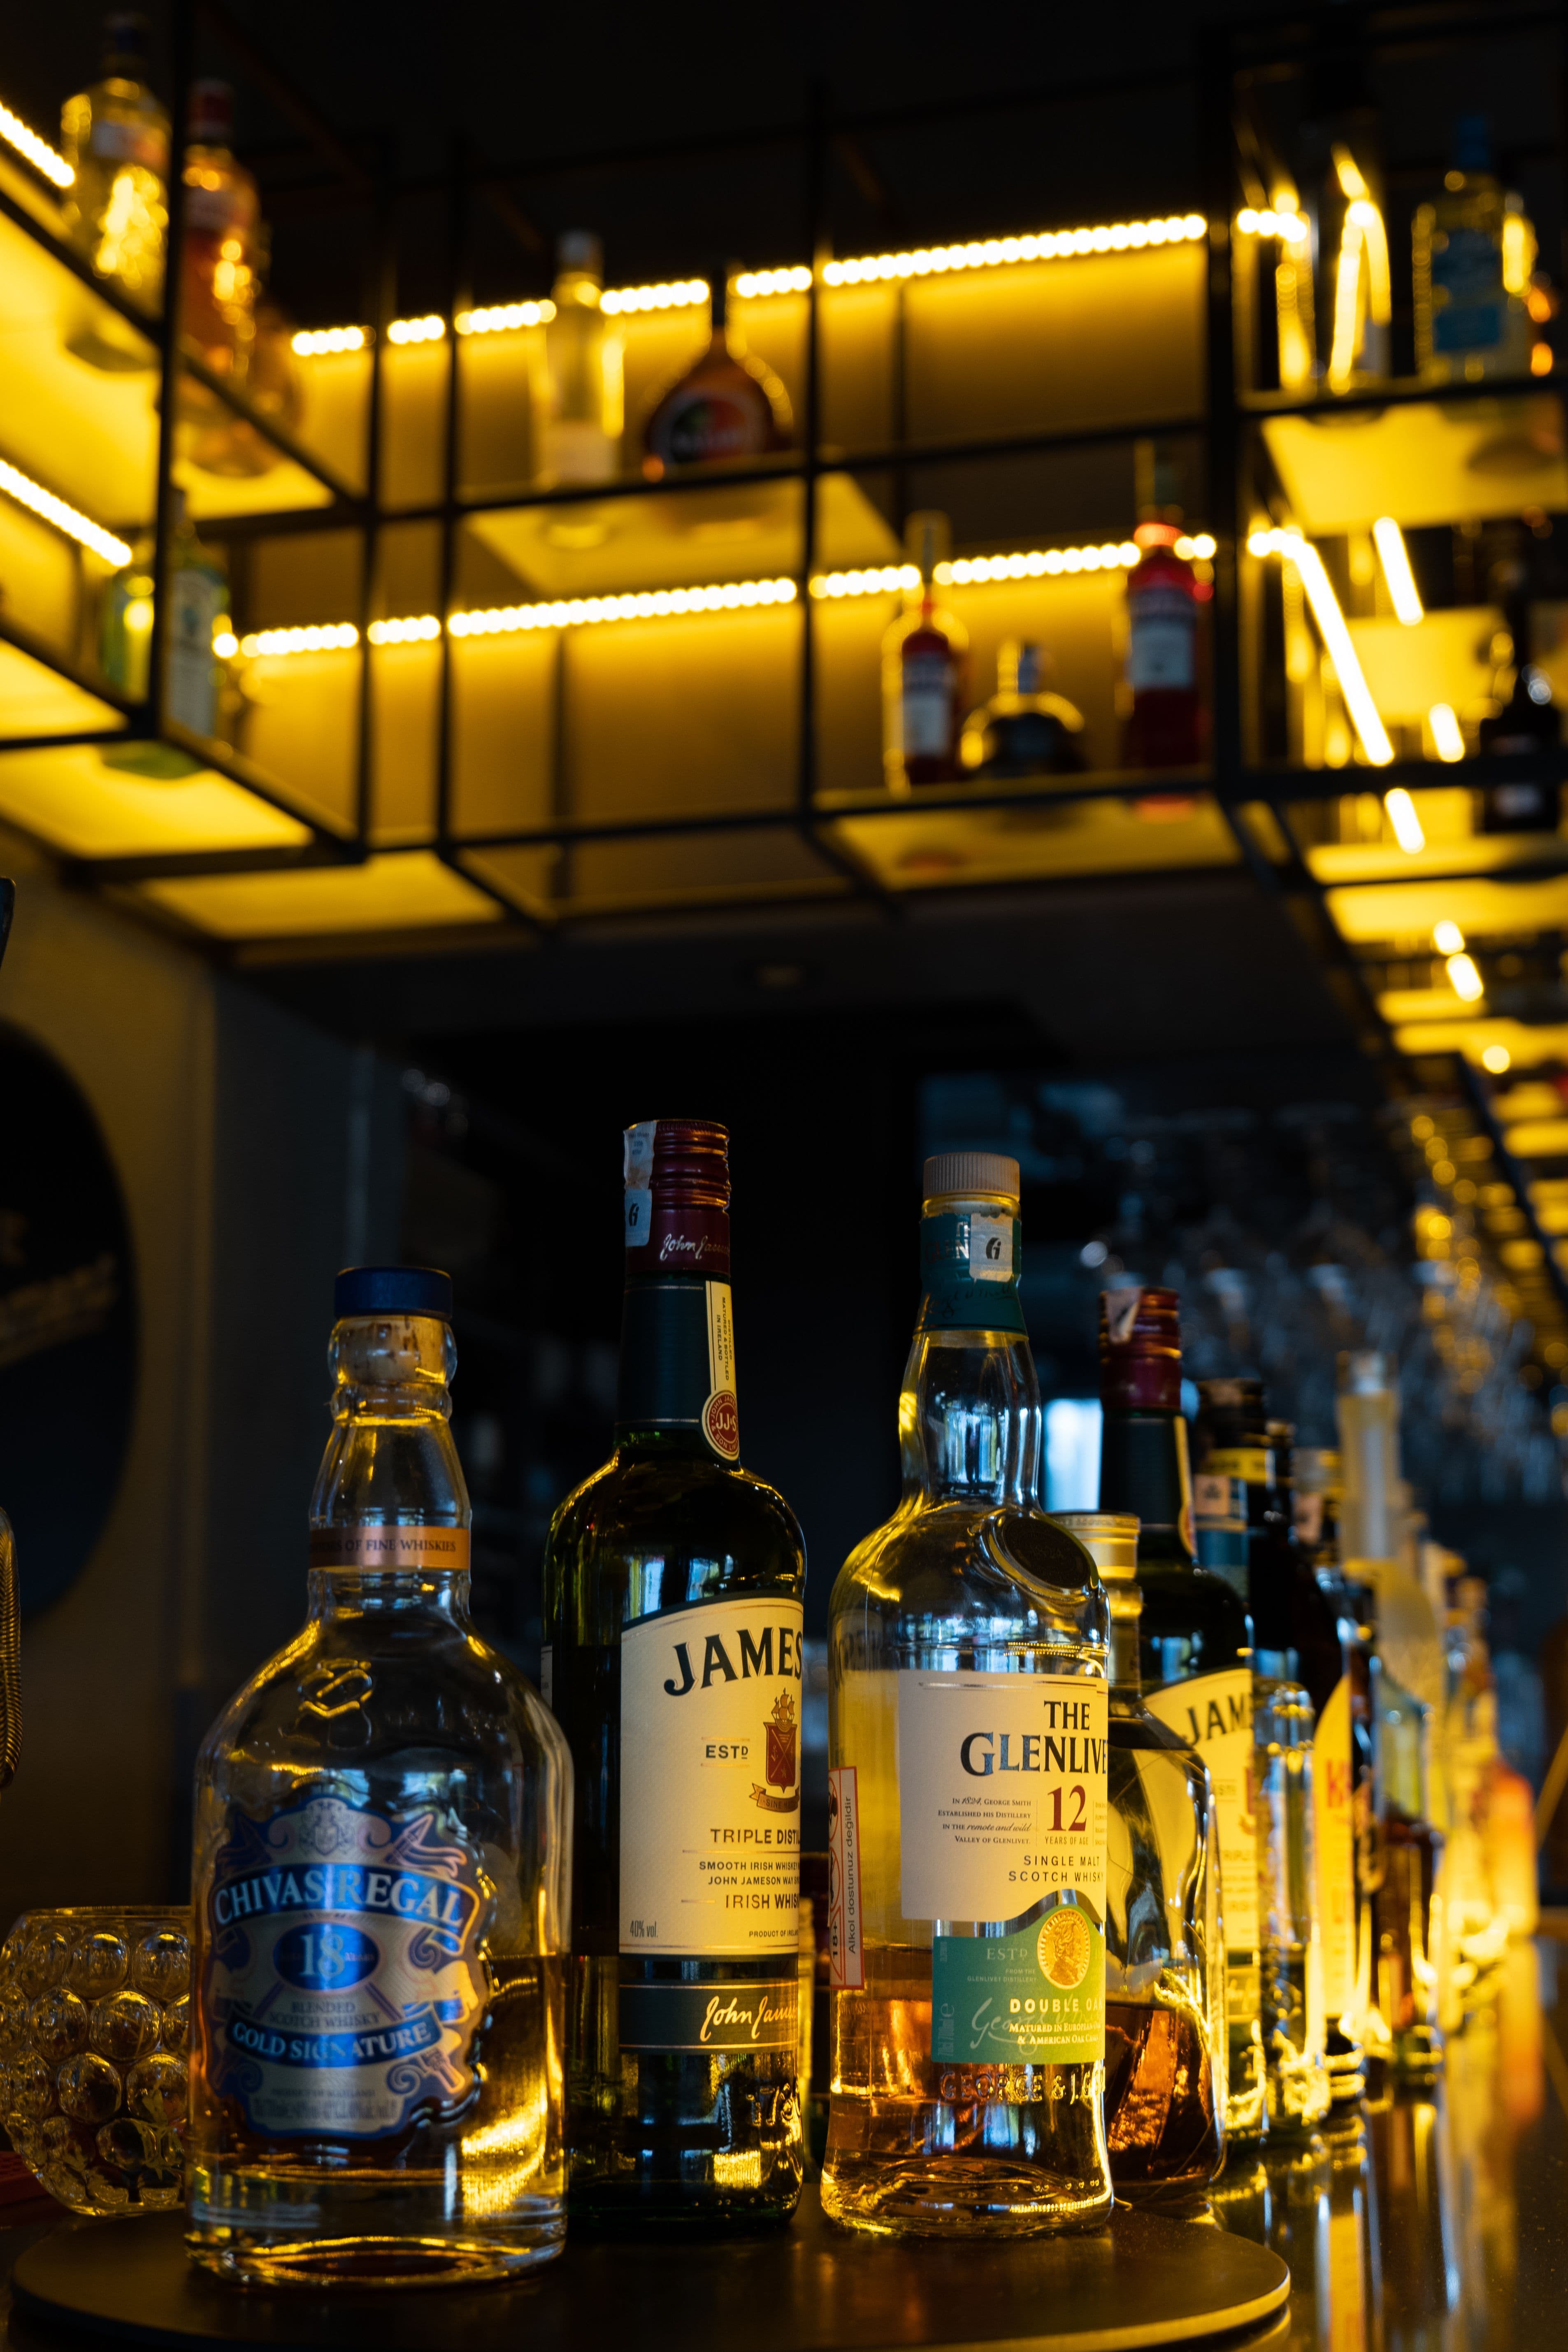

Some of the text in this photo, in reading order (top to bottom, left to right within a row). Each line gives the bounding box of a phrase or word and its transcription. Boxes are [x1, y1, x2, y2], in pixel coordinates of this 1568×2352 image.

[660, 1233, 696, 1261] John
[717, 1314, 721, 1323] IN
[715, 1434, 728, 1449] SON
[345, 1539, 361, 1551] OF
[366, 1539, 397, 1550] FINE
[401, 1539, 456, 1552] WHISKIES
[1044, 1700, 1090, 1730] THE
[1047, 1785, 1087, 1831] 12
[845, 1796, 854, 1847] değildir
[995, 1822, 1014, 1831] and
[710, 1828, 772, 1844] TRIPLE
[1045, 1836, 1067, 1845] YEARS
[1070, 1836, 1077, 1845] OF
[1079, 1836, 1089, 1845] AGE
[699, 1861, 746, 1870] SMOOTH
[750, 1861, 773, 1870] IRISH
[1024, 1855, 1100, 1866] SINGLE MALT
[708, 1876, 737, 1885] JOHN
[741, 1876, 781, 1885] JAMESON
[783, 1876, 794, 1885] WAY
[1009, 1871, 1067, 1882] SCOTCH
[214, 1868, 464, 1928] CHIVAS REGAL
[725, 1894, 770, 1909] IRISH
[630, 1920, 658, 1938] 40% vol.
[300, 1933, 345, 1976] 18
[1010, 1998, 1079, 2013] DOUBLE
[700, 1996, 752, 2042] John
[1009, 2022, 1053, 2033] MATURED
[1064, 2022, 1094, 2032] EUROPEAN
[232, 2020, 432, 2059] GOLD SIGNATURE
[1017, 2035, 1026, 2045] &
[1029, 2035, 1071, 2045] AMERICAN
[1072, 2034, 1085, 2043] OAK
